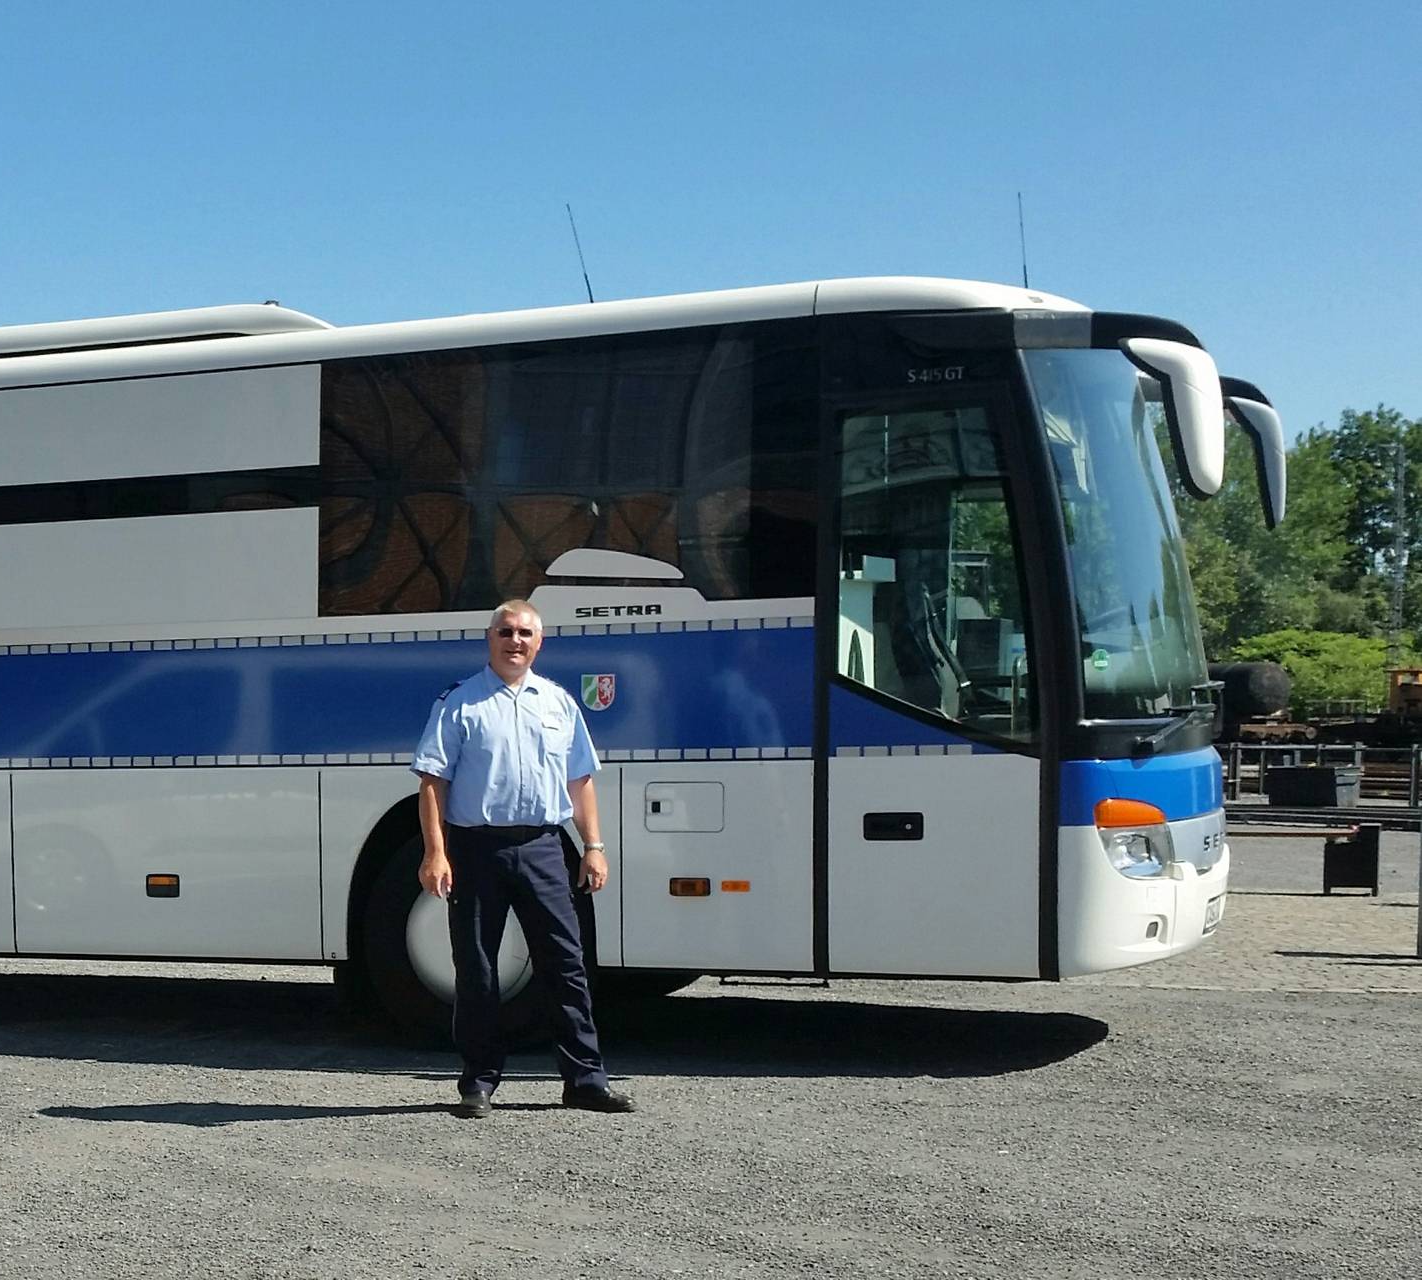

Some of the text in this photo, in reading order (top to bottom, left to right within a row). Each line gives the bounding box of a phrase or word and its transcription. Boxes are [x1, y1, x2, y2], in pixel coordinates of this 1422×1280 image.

[907, 369, 916, 383] S
[945, 366, 965, 381] GT
[575, 604, 662, 618] SETRA
